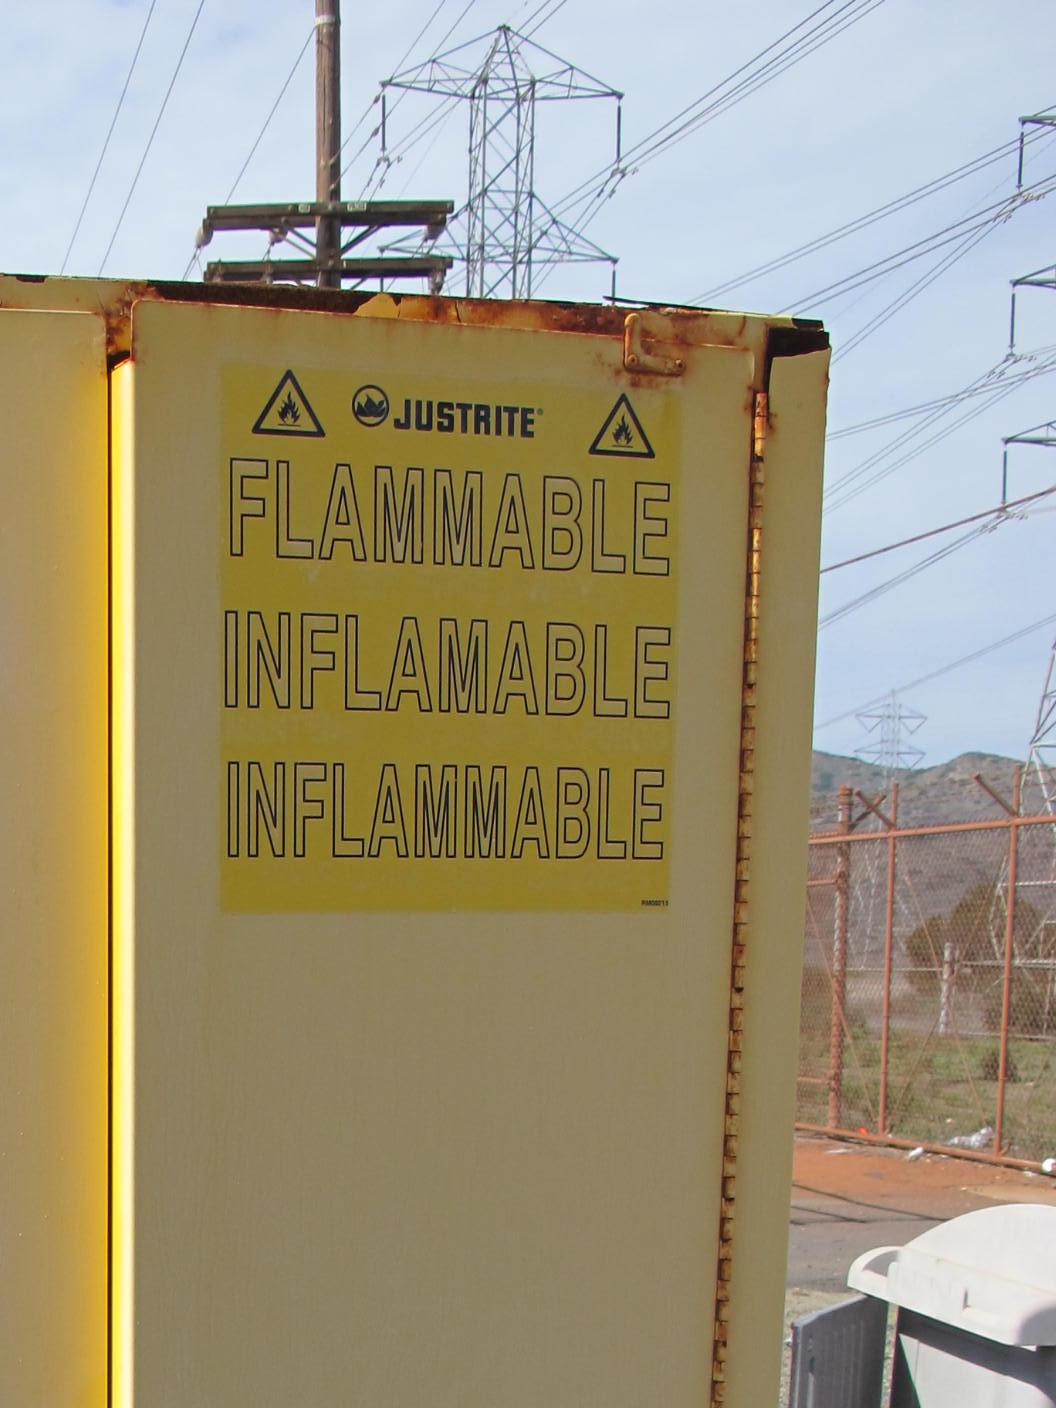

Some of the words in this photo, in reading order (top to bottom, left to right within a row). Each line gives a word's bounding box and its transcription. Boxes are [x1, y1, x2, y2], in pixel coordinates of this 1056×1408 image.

[393, 398, 536, 439] JUSTRITE
[229, 457, 671, 577] FLAMMABLE
[224, 610, 671, 719] INFLAMABLE
[227, 760, 665, 861] INFLAMMABLE
